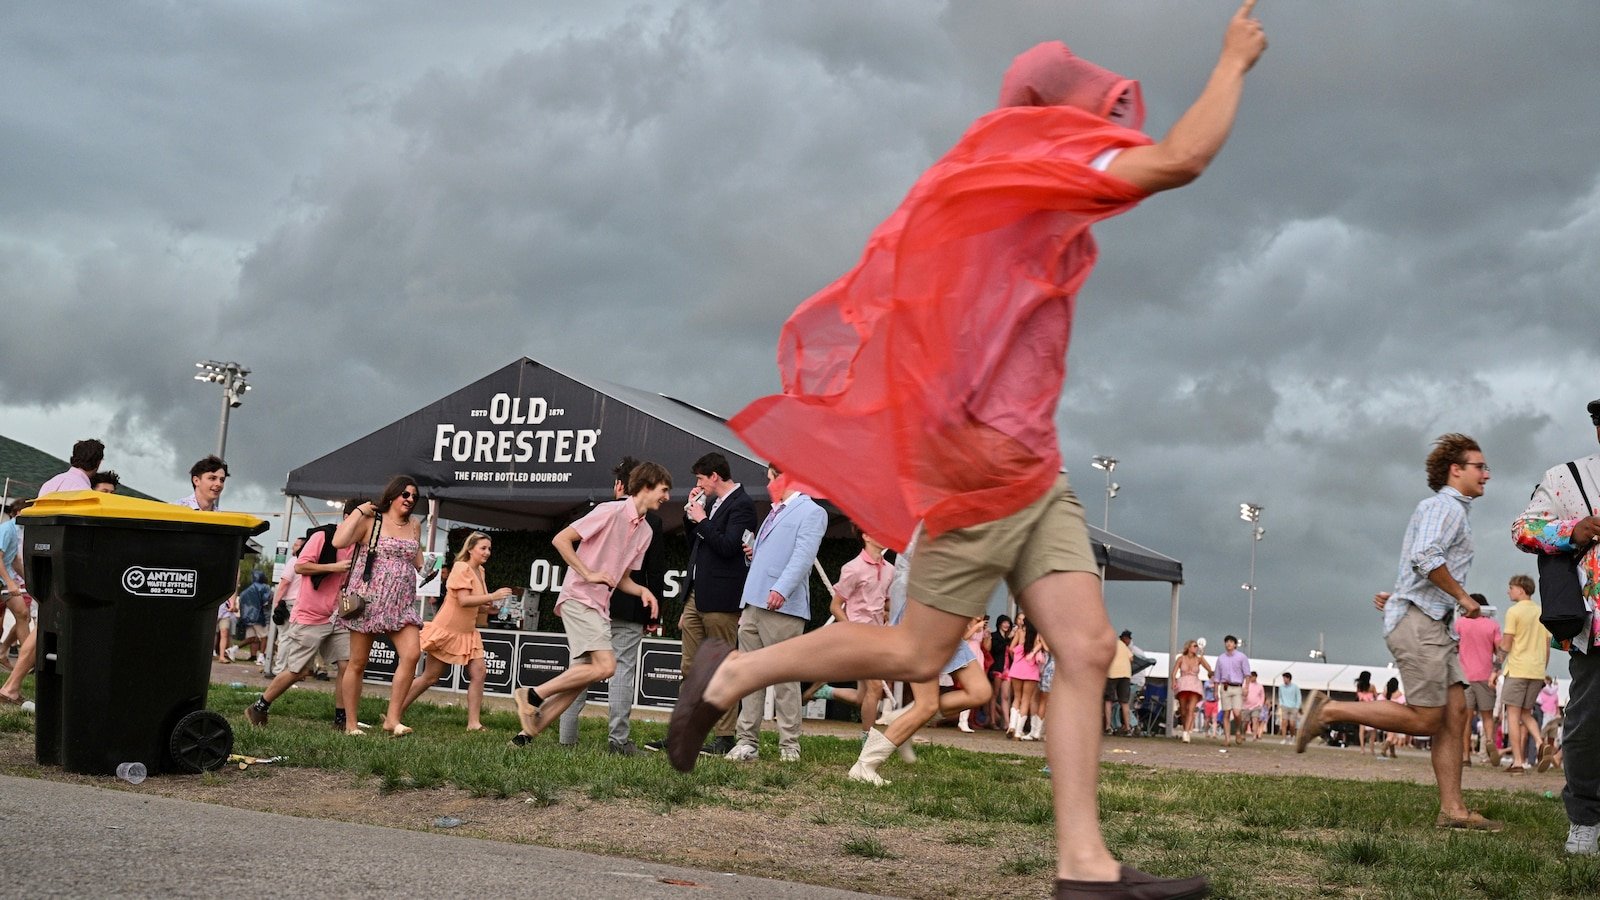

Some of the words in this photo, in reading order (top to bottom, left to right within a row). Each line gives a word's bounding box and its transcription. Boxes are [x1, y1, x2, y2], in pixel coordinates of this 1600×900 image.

[489, 393, 547, 424] OLD
[548, 408, 564, 416] 1870
[454, 471, 470, 481] THE
[471, 472, 494, 481] FIRST
[495, 472, 529, 482] BOTTLED
[147, 571, 194, 581] ANYTIME
[529, 559, 565, 592] OL
[372, 640, 386, 650] OLD
[368, 648, 396, 660] RESTER
